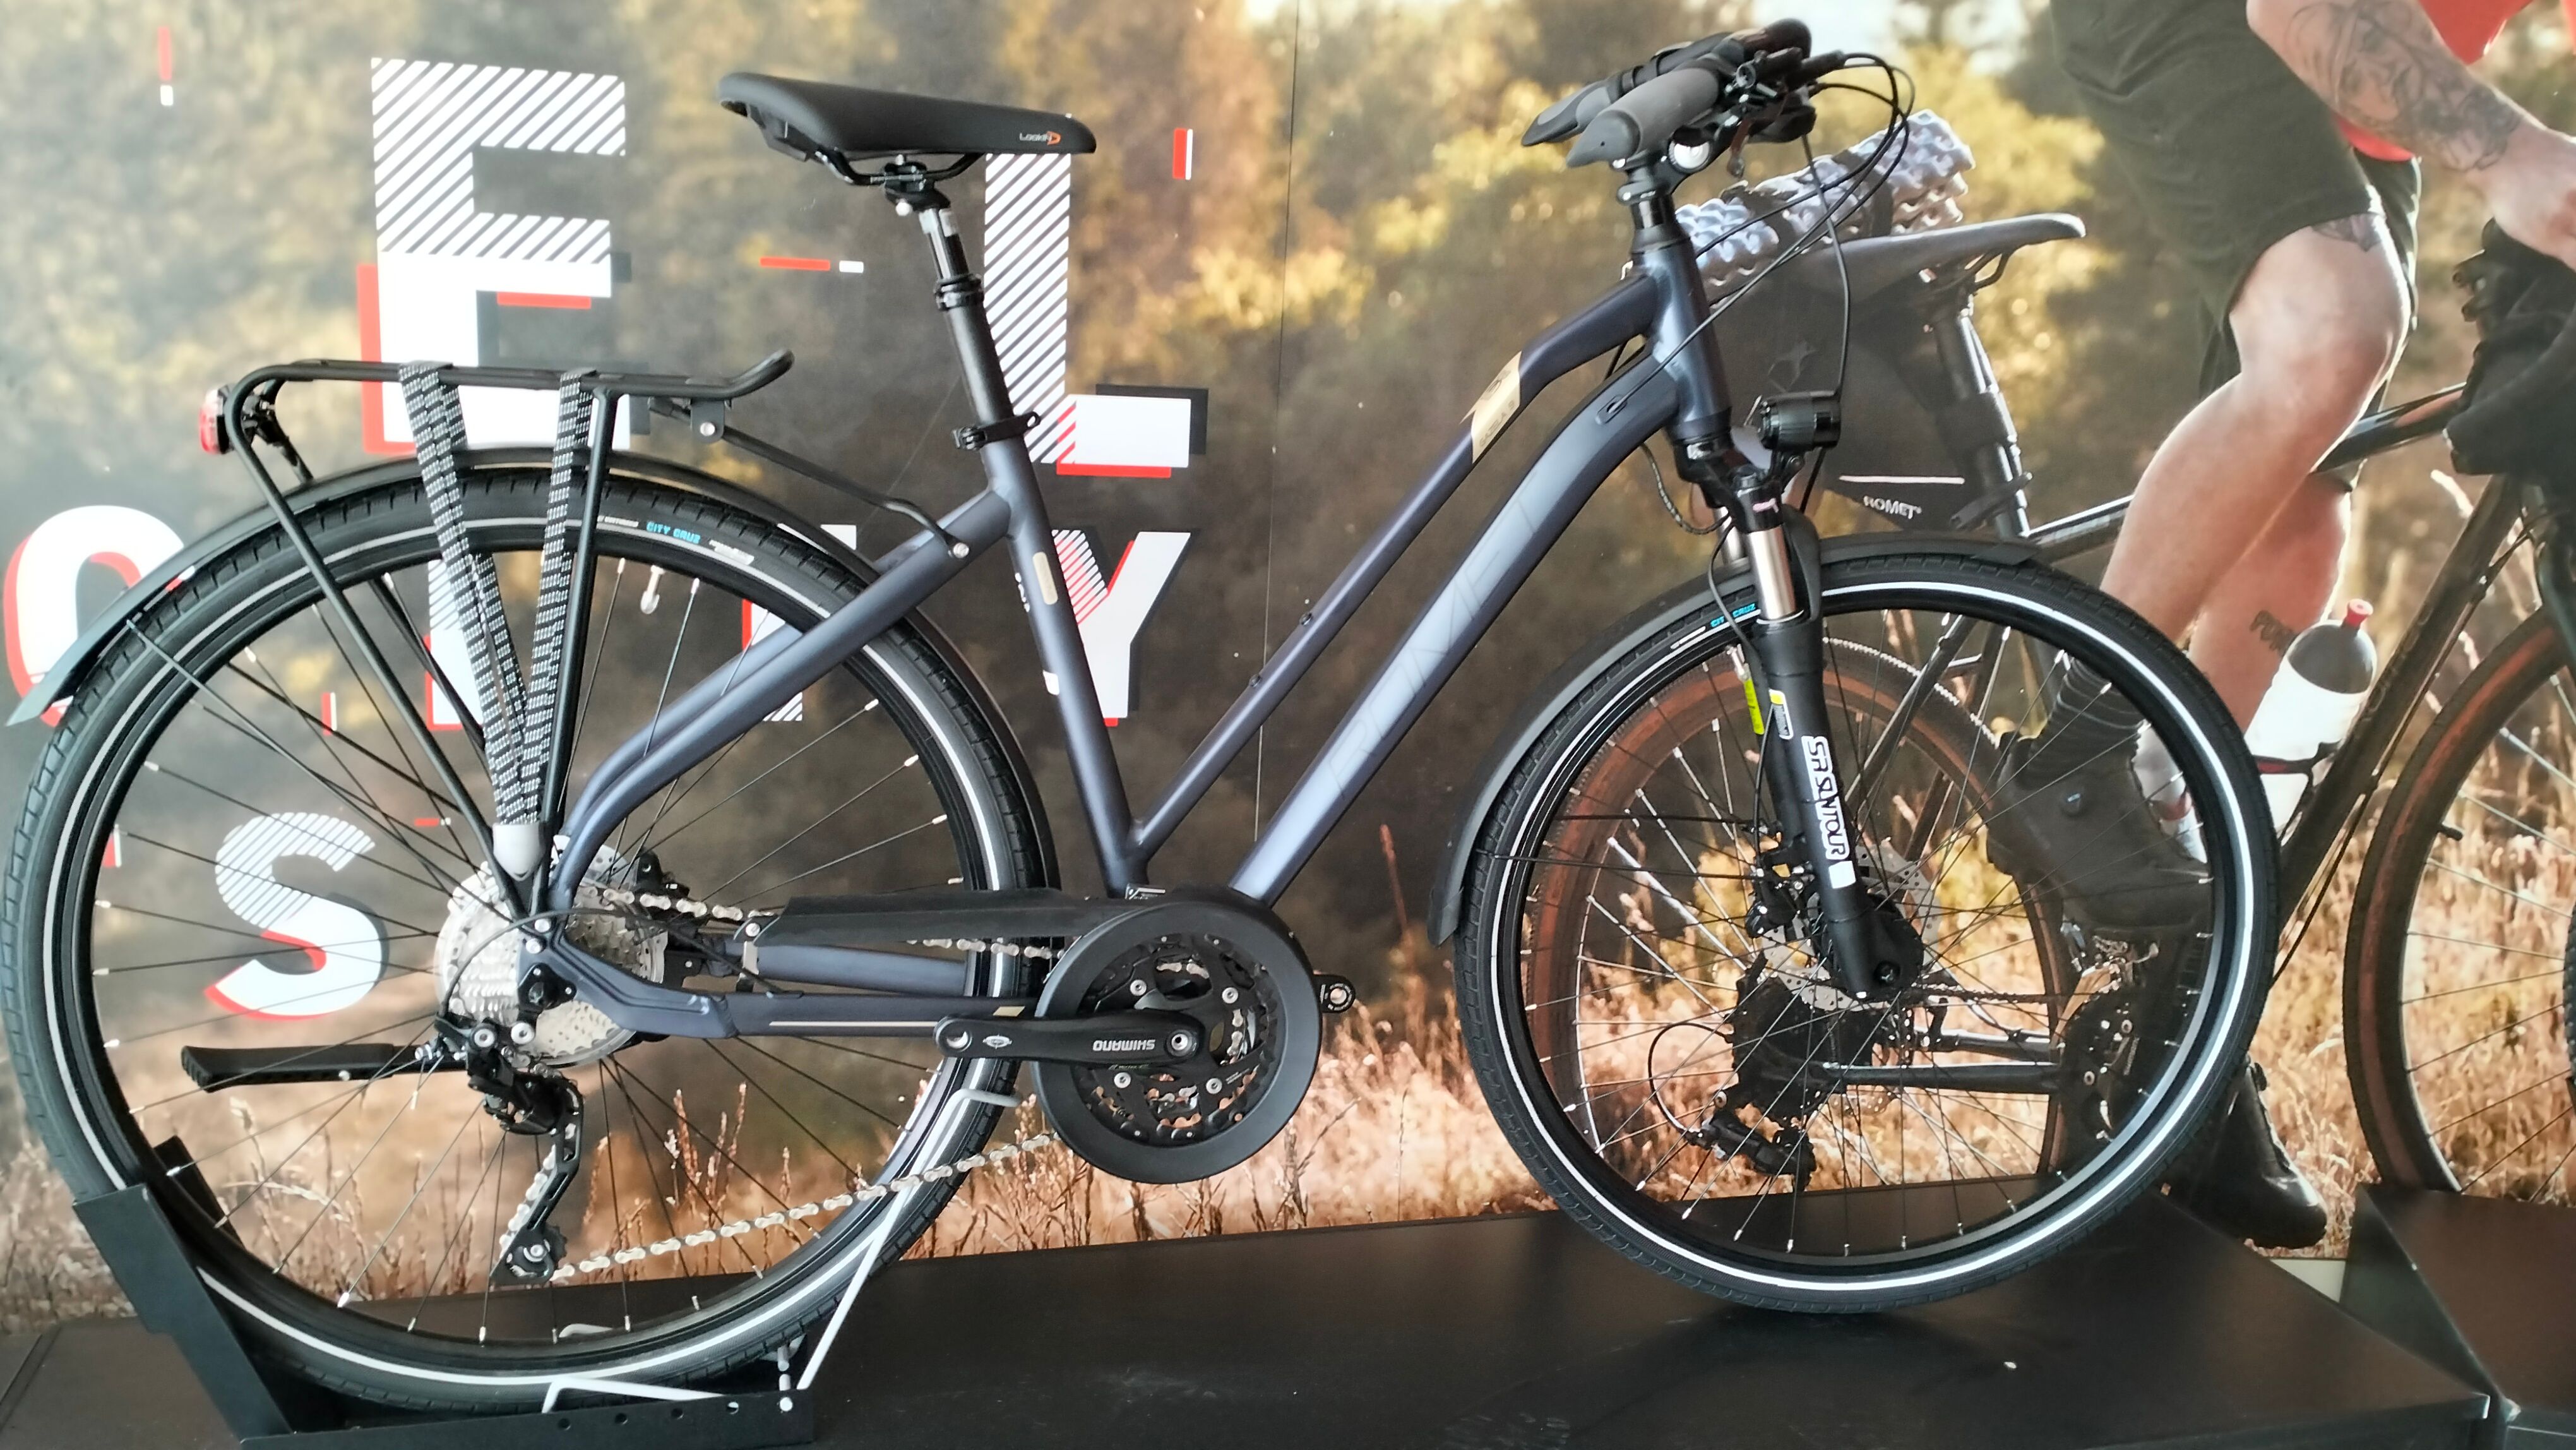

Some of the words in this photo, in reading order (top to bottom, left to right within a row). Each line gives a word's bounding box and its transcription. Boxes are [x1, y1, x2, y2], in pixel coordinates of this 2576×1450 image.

[646, 521, 671, 534] CITY
[1329, 470, 1537, 798] ROMET
[1806, 738, 1830, 773] SR
[1093, 1039, 1156, 1052] SHIMANO
